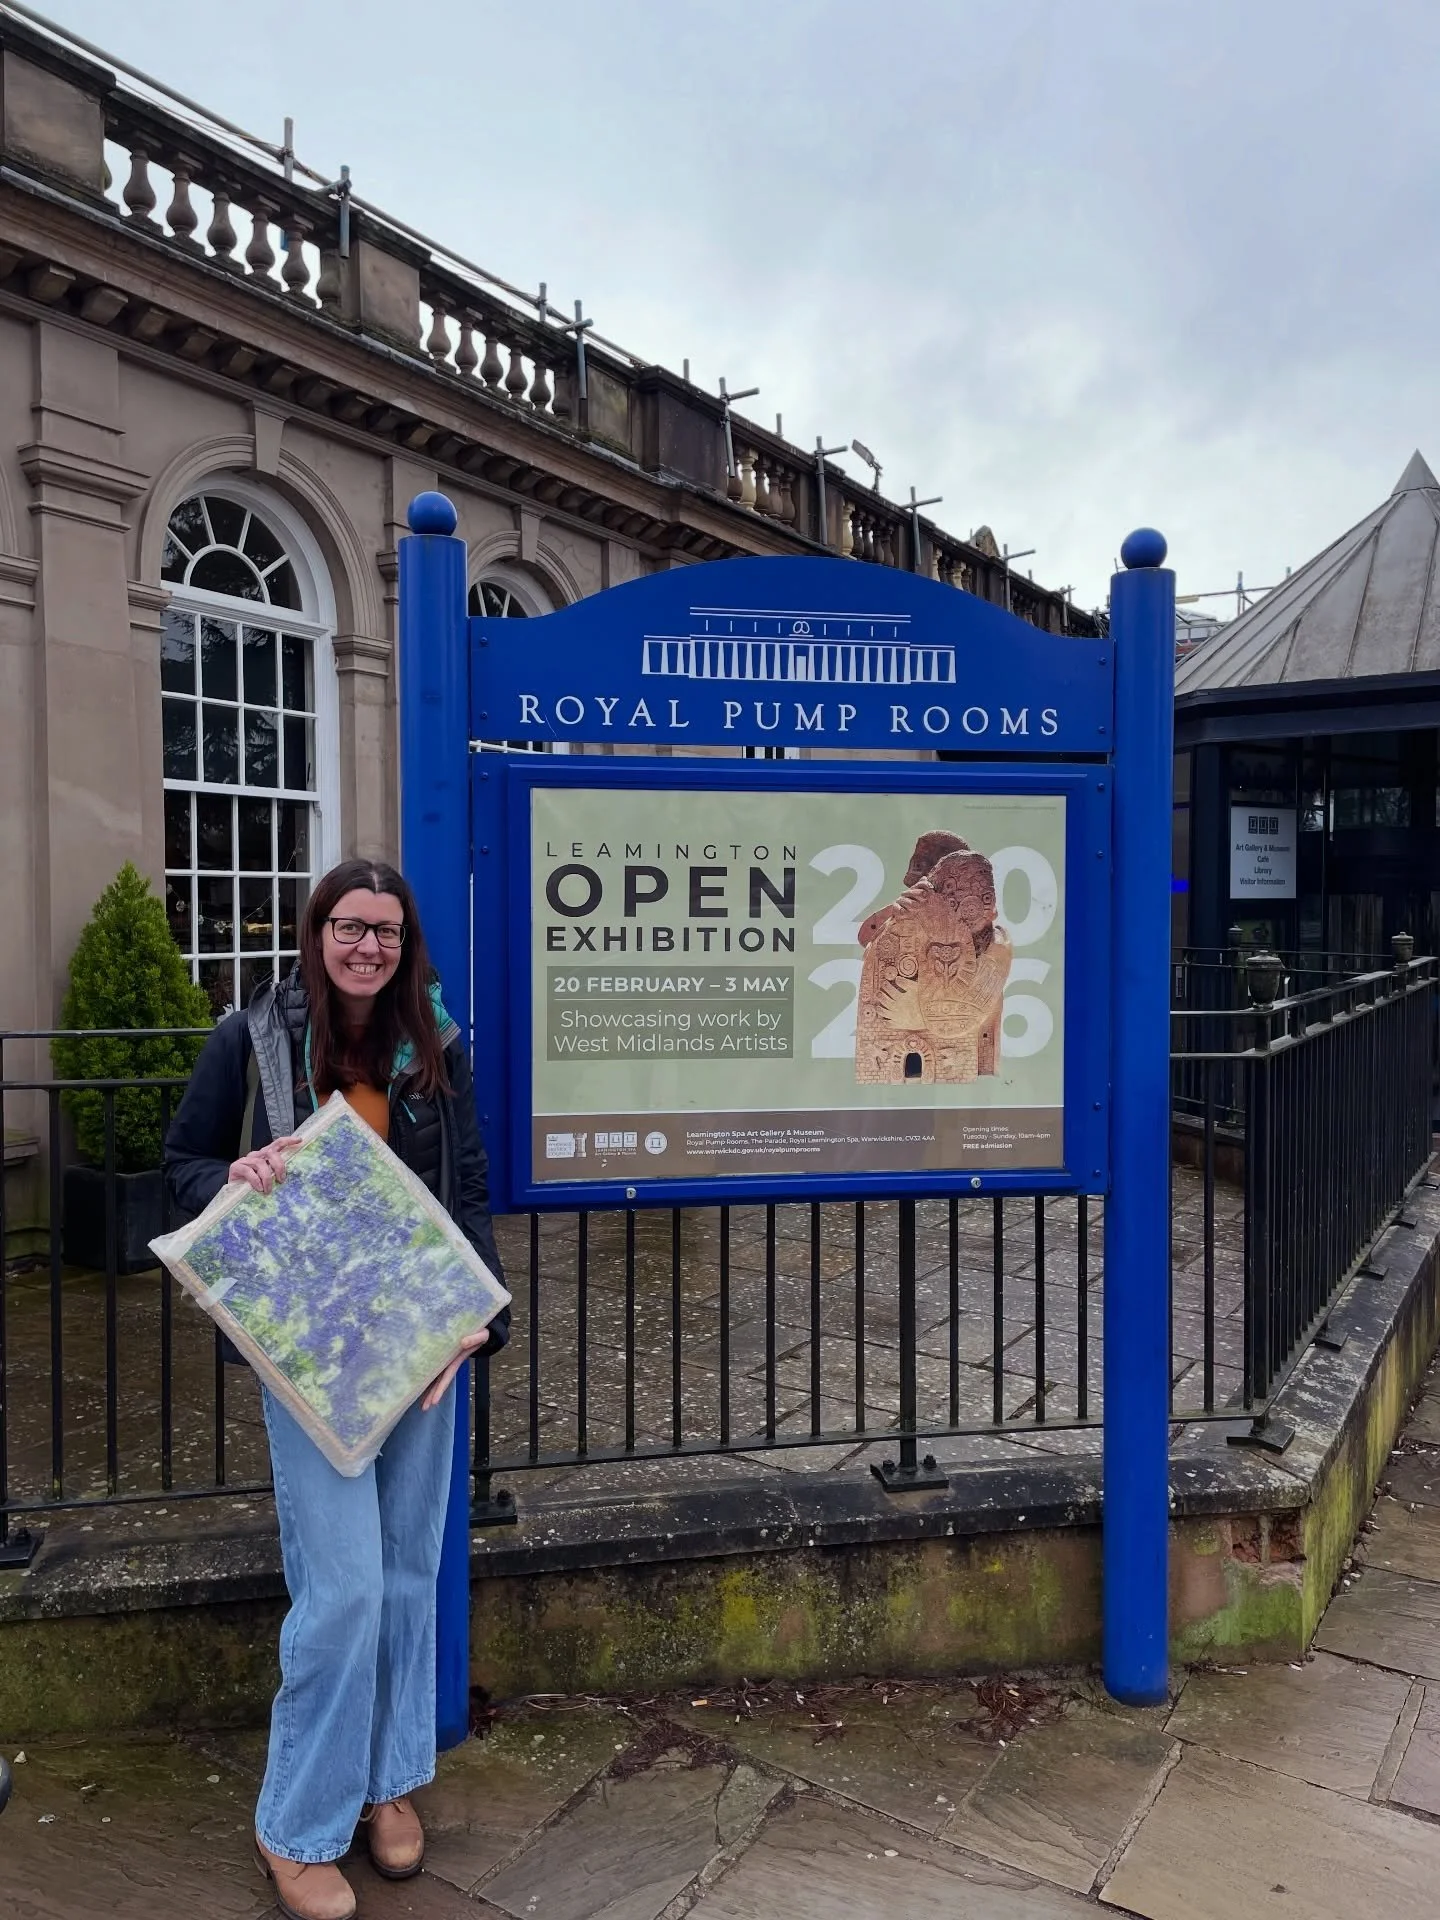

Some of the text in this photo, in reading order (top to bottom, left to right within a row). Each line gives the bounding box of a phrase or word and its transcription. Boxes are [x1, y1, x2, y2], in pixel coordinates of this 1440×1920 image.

[519, 694, 1060, 736] ROYAL PUMP ROOMS
[546, 841, 796, 861] LEAMINGTON
[545, 863, 796, 919] OPEN
[546, 926, 796, 953] EXHIBITION
[553, 976, 581, 994] 20
[586, 976, 705, 994] FEBRUARY
[724, 976, 738, 993] 3
[742, 976, 790, 993] MAY
[560, 1008, 783, 1031] Showcasing work by
[553, 1031, 789, 1053] West Midlands Artists
[686, 1130, 731, 1139] Leamington
[731, 1130, 746, 1138] Spa
[759, 1129, 786, 1138] Gallery
[686, 1139, 704, 1147] Royal
[705, 1139, 726, 1147] Pump
[789, 1137, 807, 1145] Royal
[807, 1136, 846, 1145] Leamington
[962, 1133, 989, 1141] Tuesday
[980, 1142, 1013, 1150] admission
